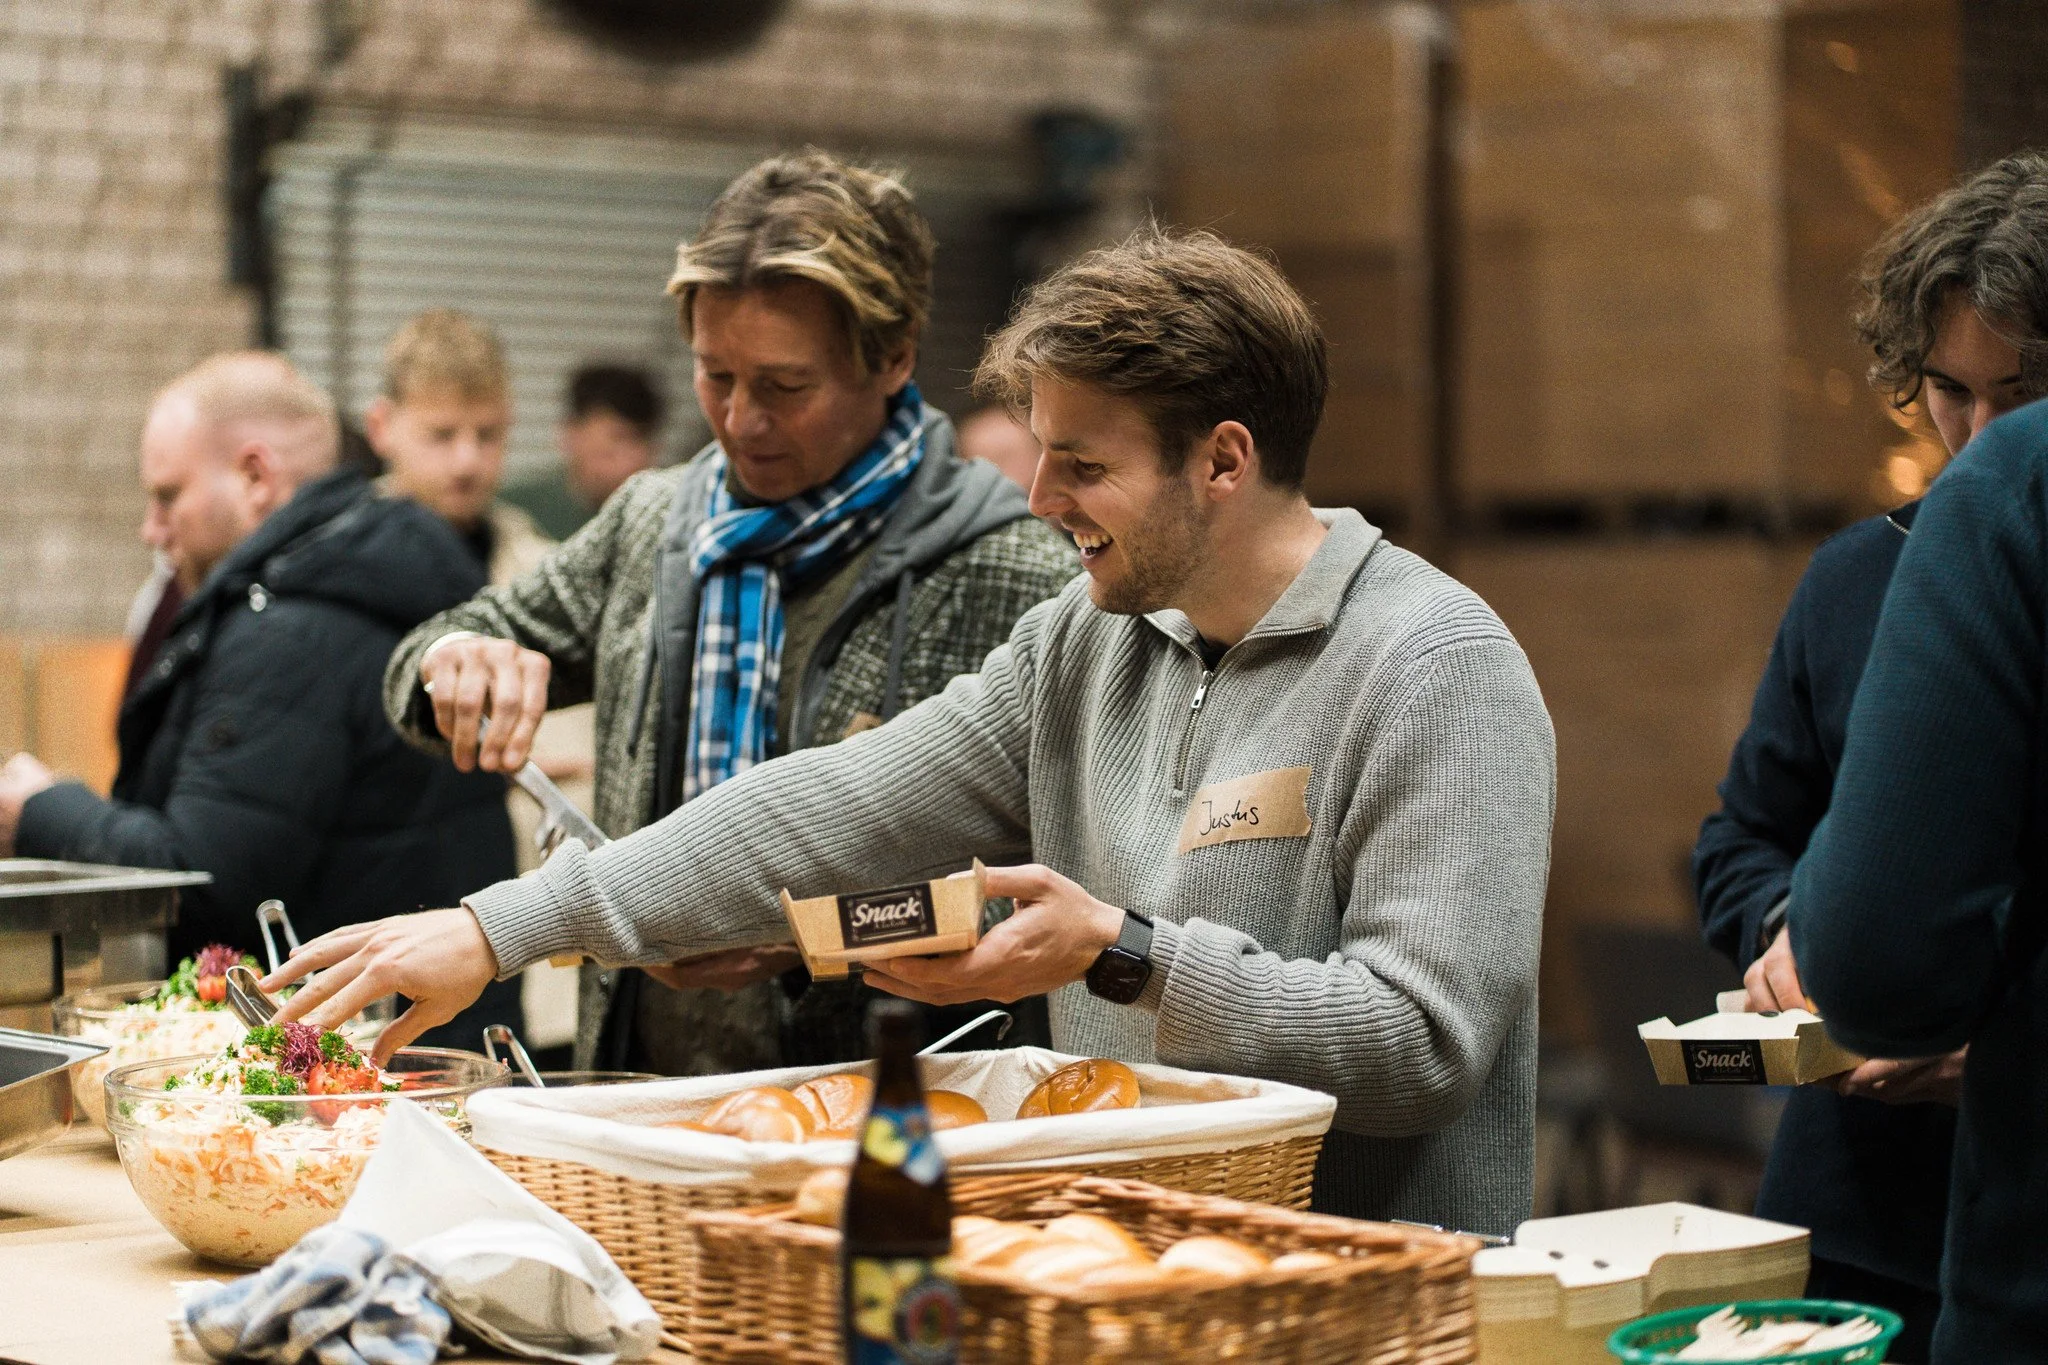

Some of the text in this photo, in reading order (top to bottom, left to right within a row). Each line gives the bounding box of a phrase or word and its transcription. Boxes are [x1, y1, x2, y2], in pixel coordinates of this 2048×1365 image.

[1199, 799, 1260, 836] Justus
[852, 896, 921, 928] Snack
[1695, 1049, 1751, 1069] Snack
